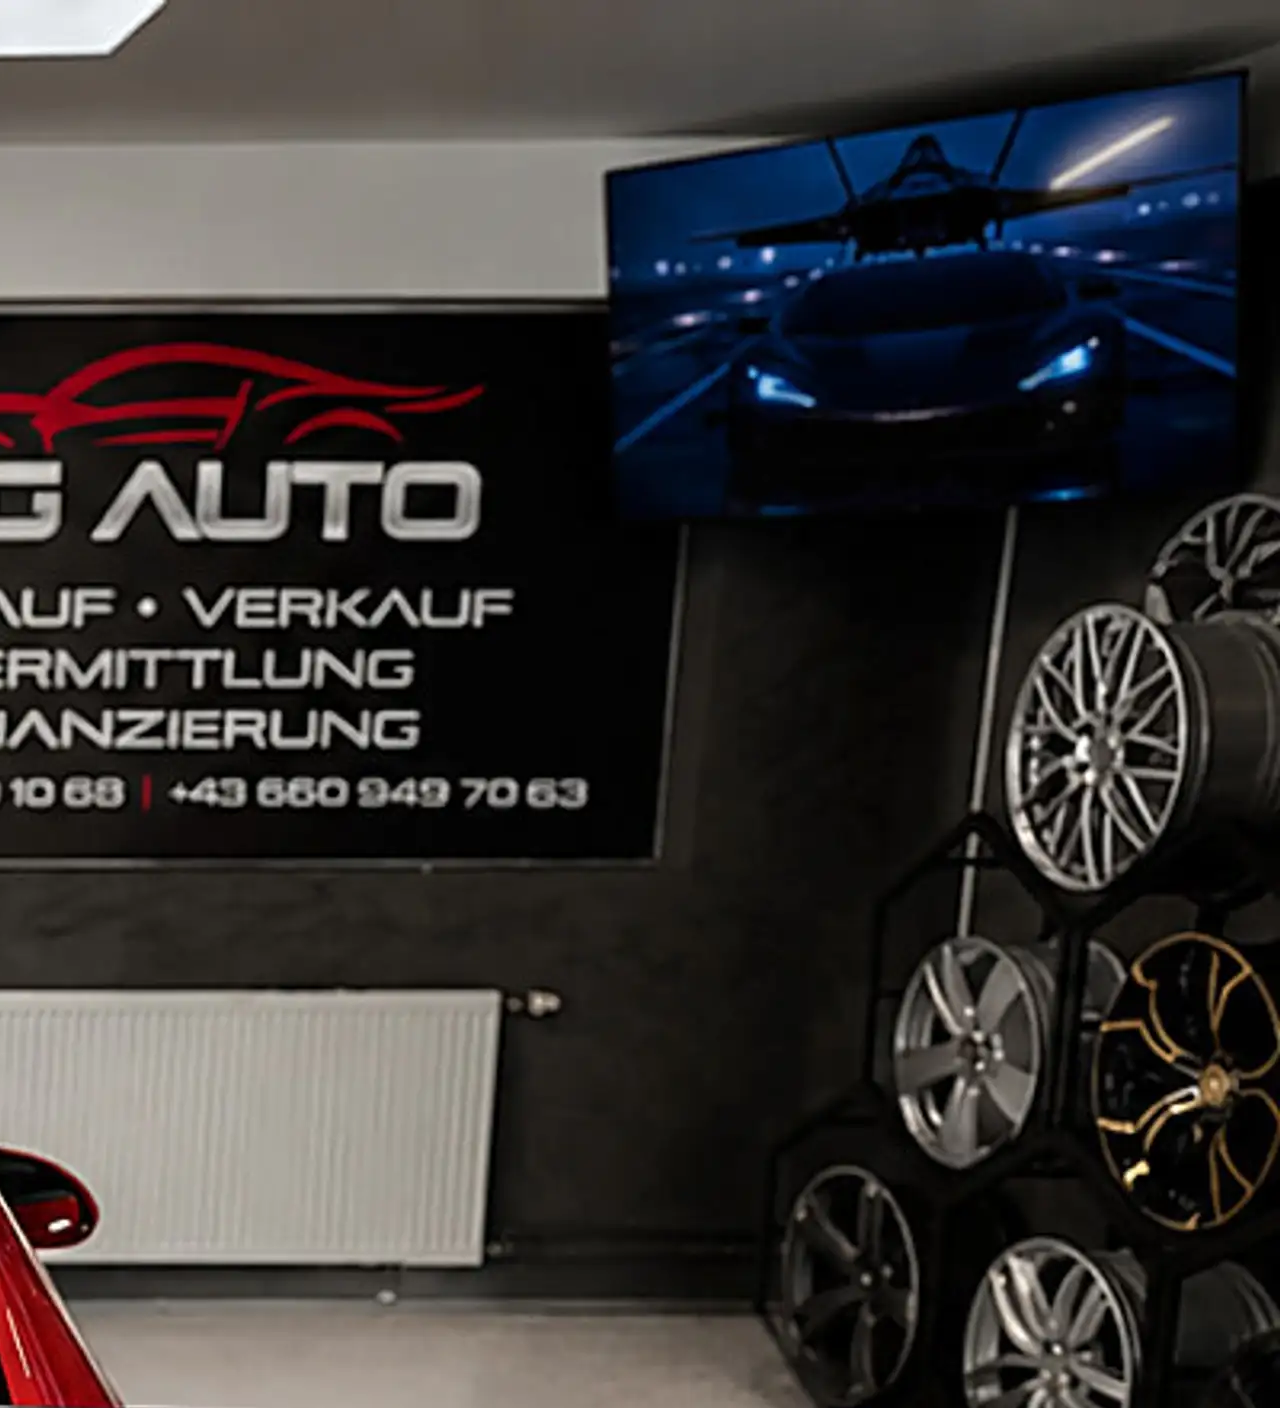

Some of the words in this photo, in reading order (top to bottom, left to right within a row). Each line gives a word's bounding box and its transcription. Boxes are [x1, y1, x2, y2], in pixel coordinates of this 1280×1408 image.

[90, 460, 482, 543] AUTO
[183, 587, 514, 629] VERKAUF
[9, 777, 56, 809] 10
[168, 777, 247, 809] +43
[256, 777, 350, 809] 660
[461, 777, 519, 809] 70
